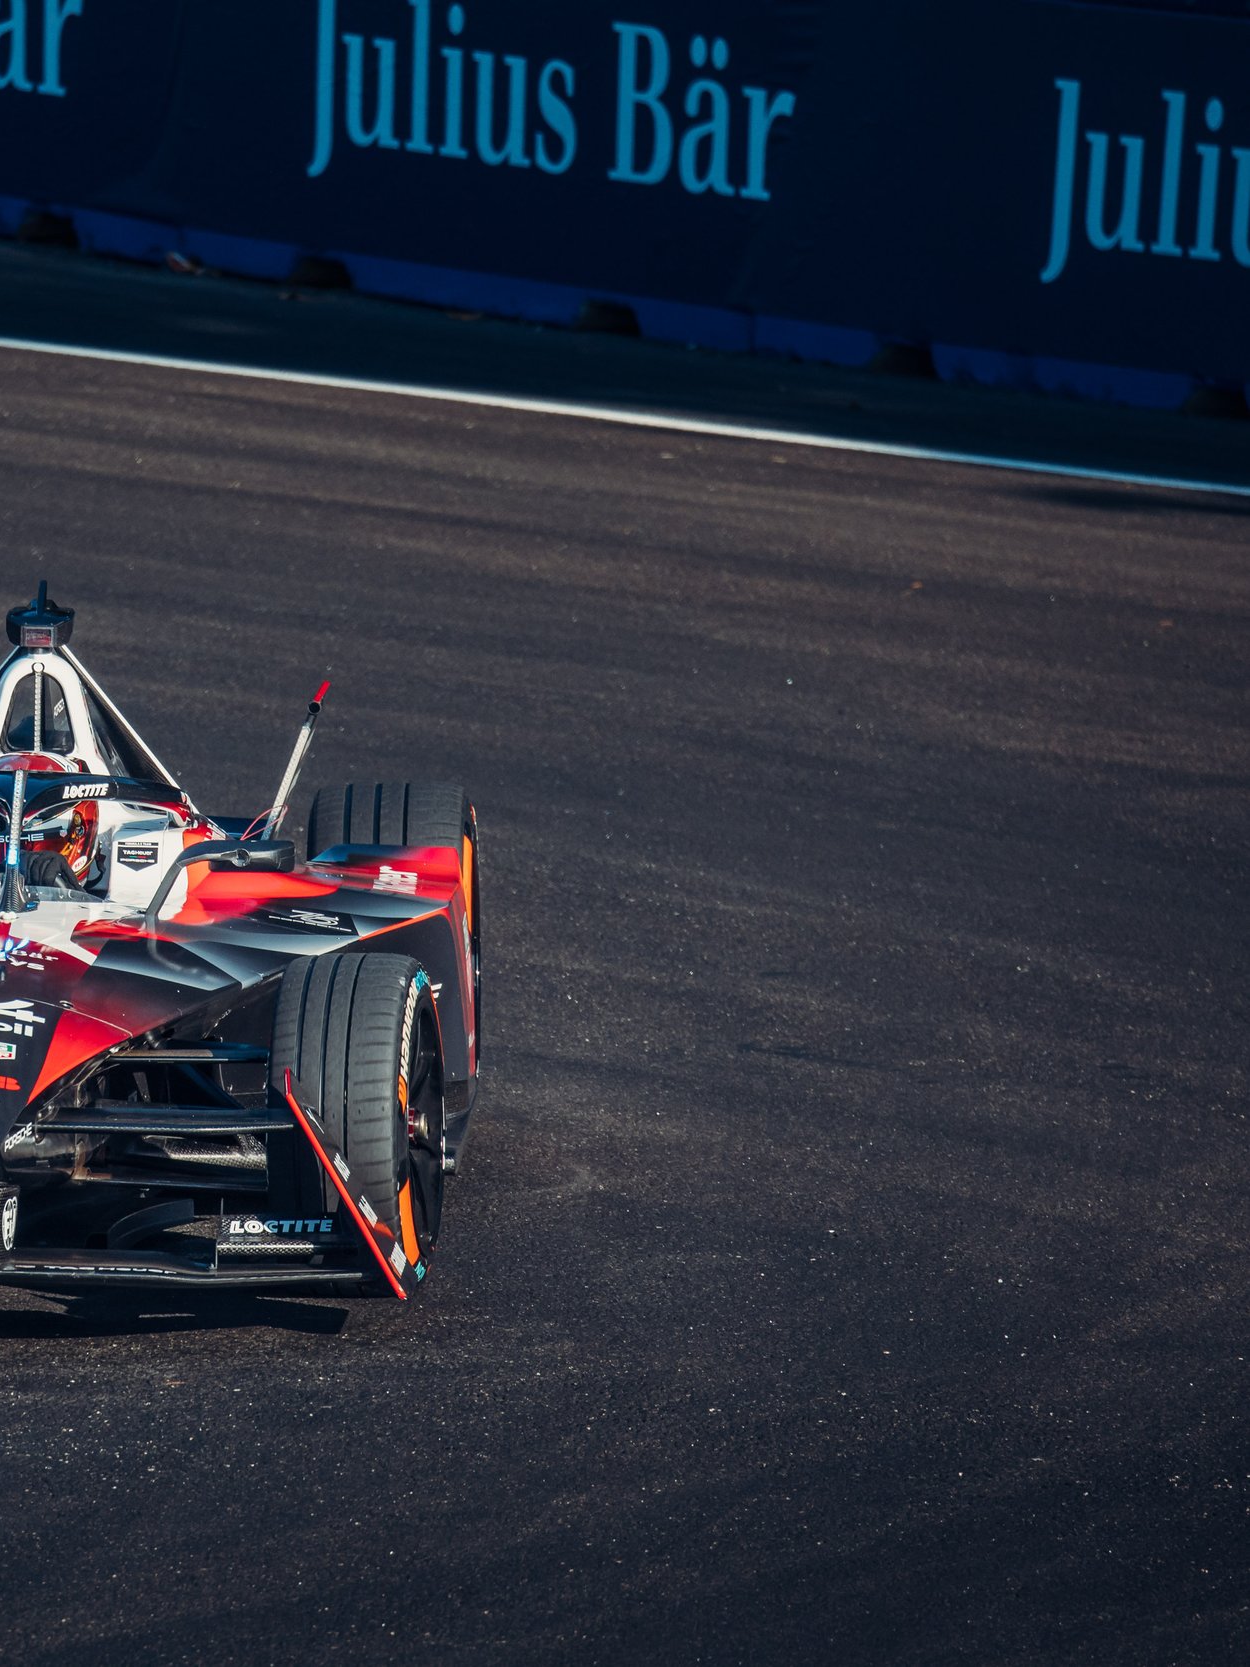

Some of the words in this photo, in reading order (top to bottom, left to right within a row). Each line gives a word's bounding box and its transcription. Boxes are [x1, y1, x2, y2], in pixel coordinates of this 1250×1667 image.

[307, 0, 577, 177] Julius
[608, 21, 797, 200] Bär
[62, 783, 109, 799] LOCTITE
[4, 1122, 32, 1152] PORSCHE
[230, 1219, 333, 1234] LOCTITE
